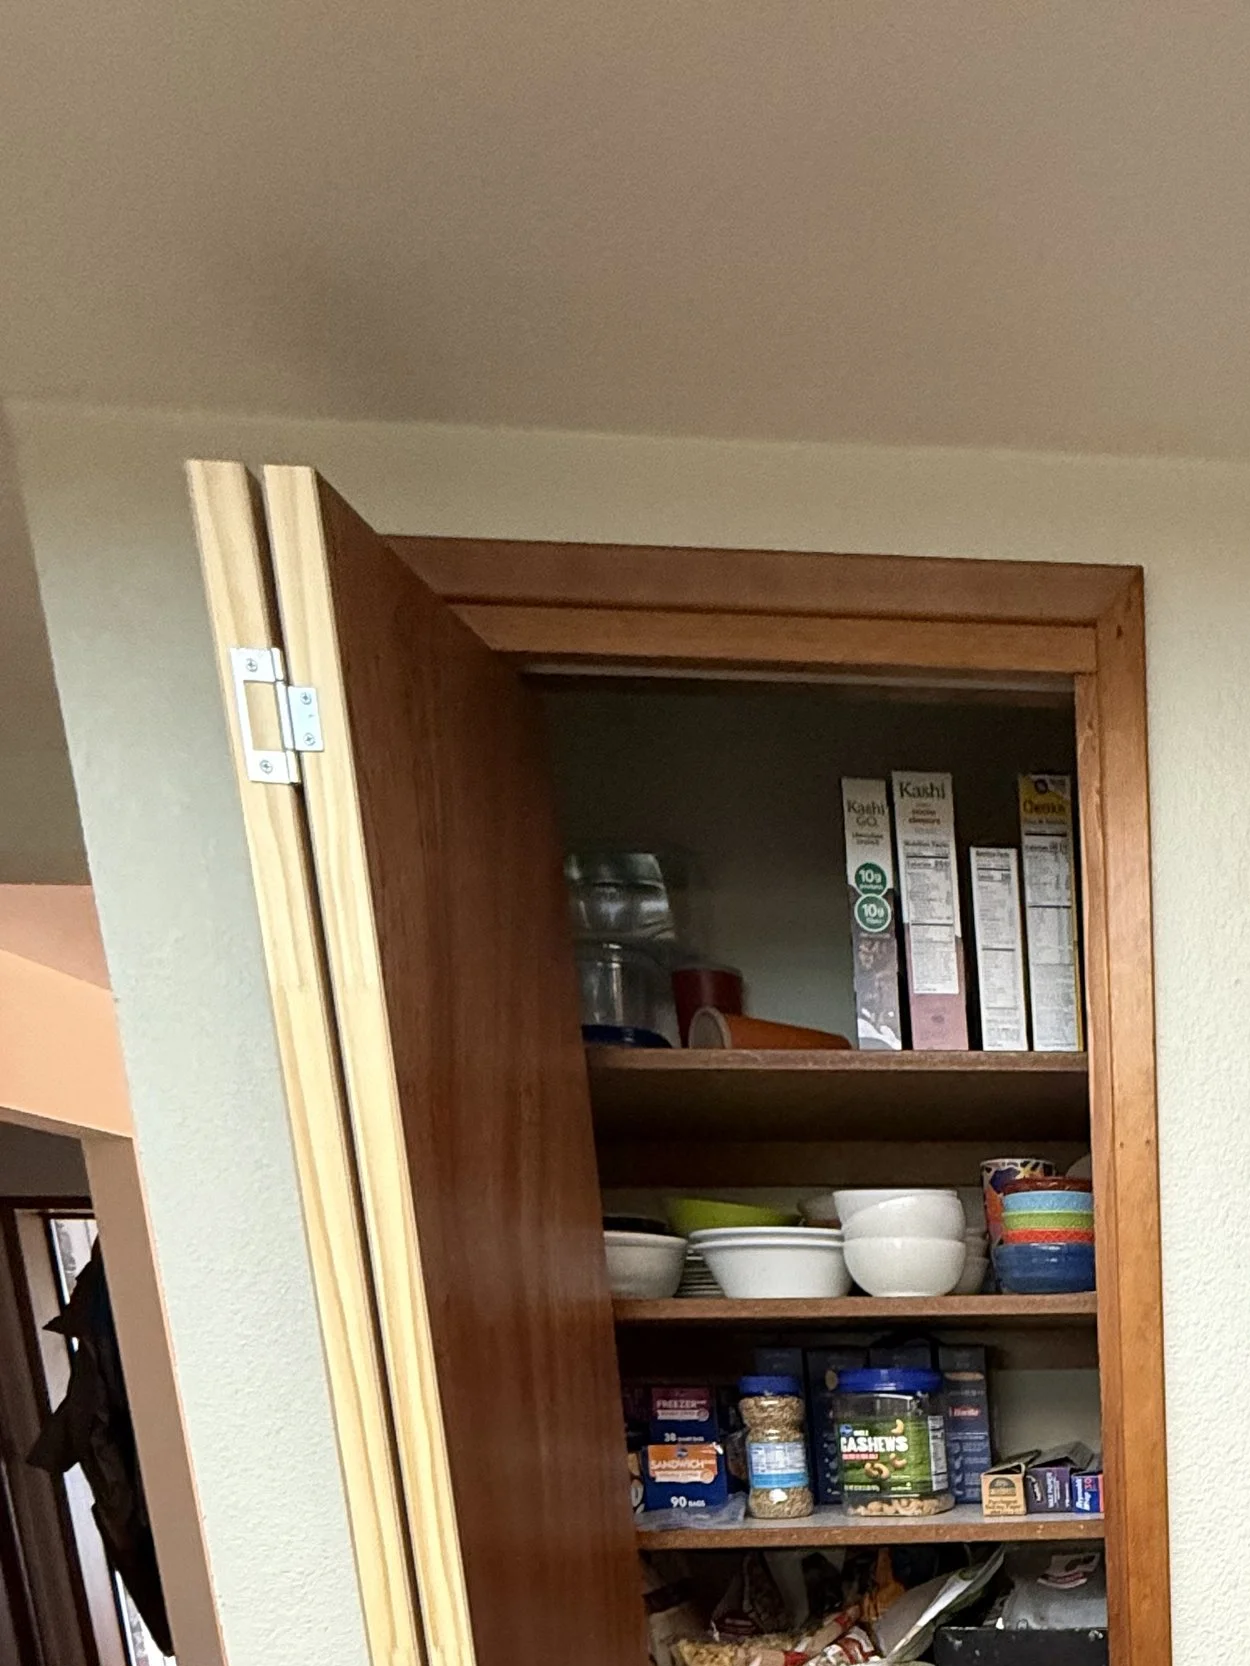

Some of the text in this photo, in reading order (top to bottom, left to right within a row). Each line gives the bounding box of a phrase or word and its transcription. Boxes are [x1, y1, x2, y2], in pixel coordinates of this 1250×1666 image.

[899, 781, 946, 799] Kashi
[848, 801, 885, 816] Kashi
[859, 869, 882, 884] 10g
[862, 903, 884, 918] 10g
[656, 1400, 697, 1409] FREEZER
[840, 1436, 909, 1453] CASHEWS
[650, 1460, 705, 1470] SANDWICH
[670, 1496, 687, 1508] 90
